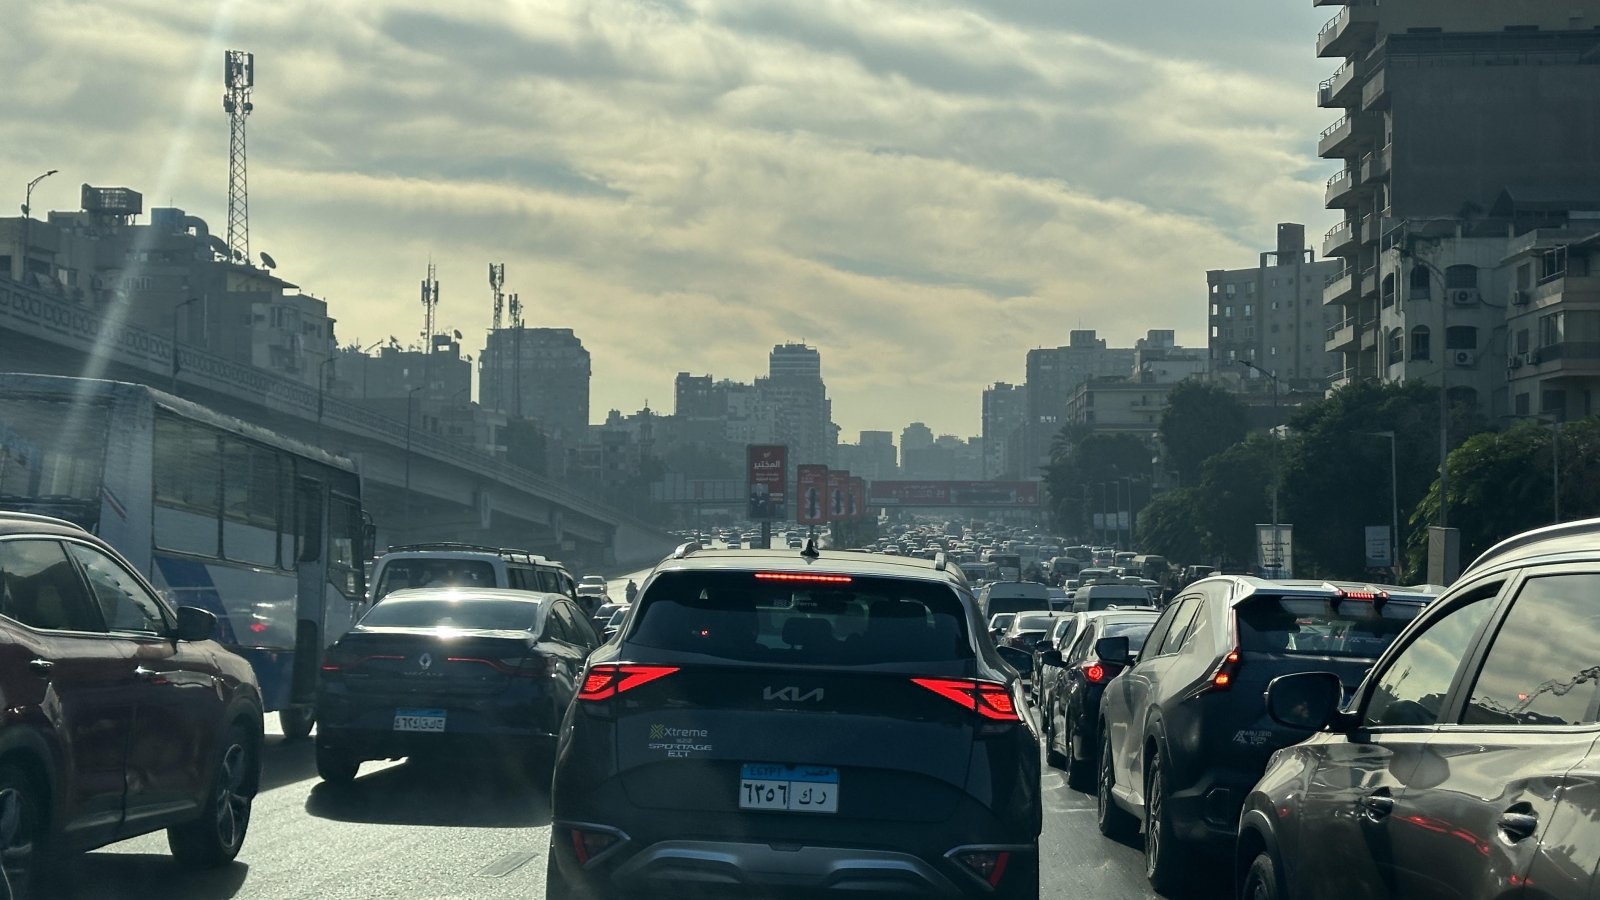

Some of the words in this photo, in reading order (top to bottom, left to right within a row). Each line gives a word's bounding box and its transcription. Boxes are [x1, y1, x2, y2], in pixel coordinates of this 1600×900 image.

[754, 460, 781, 470] المختبر
[763, 685, 824, 702] KIA
[663, 727, 708, 737] Xtreme
[648, 743, 713, 751] SPORTAGE
[750, 766, 782, 777] EGYPT
[801, 769, 830, 778] مصر
[743, 782, 787, 806] ٦٣٥٦
